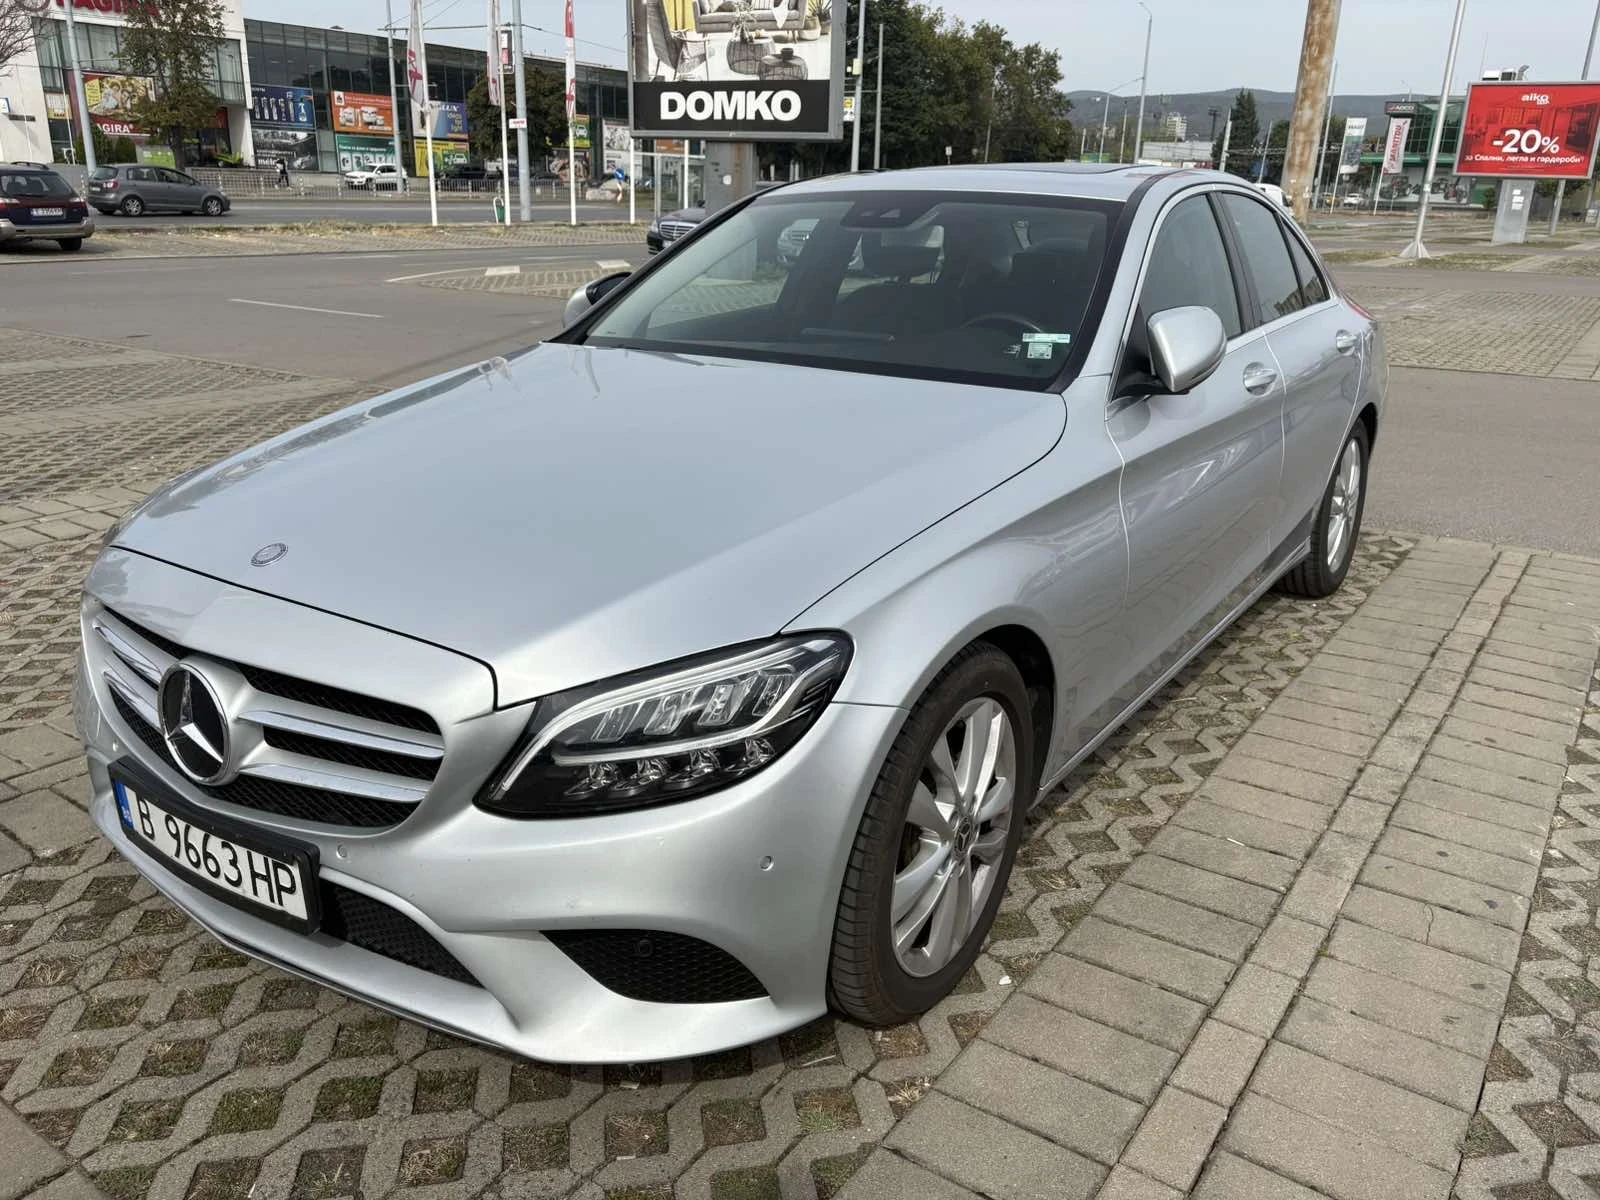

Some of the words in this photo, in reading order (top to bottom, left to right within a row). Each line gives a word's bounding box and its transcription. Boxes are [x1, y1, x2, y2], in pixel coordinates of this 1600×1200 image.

[660, 90, 802, 121] DOMKO
[1521, 93, 1549, 103] aiko
[1492, 129, 1560, 154] -20%
[137, 799, 155, 841] B
[164, 814, 243, 888] 9663
[247, 850, 297, 907] HP
